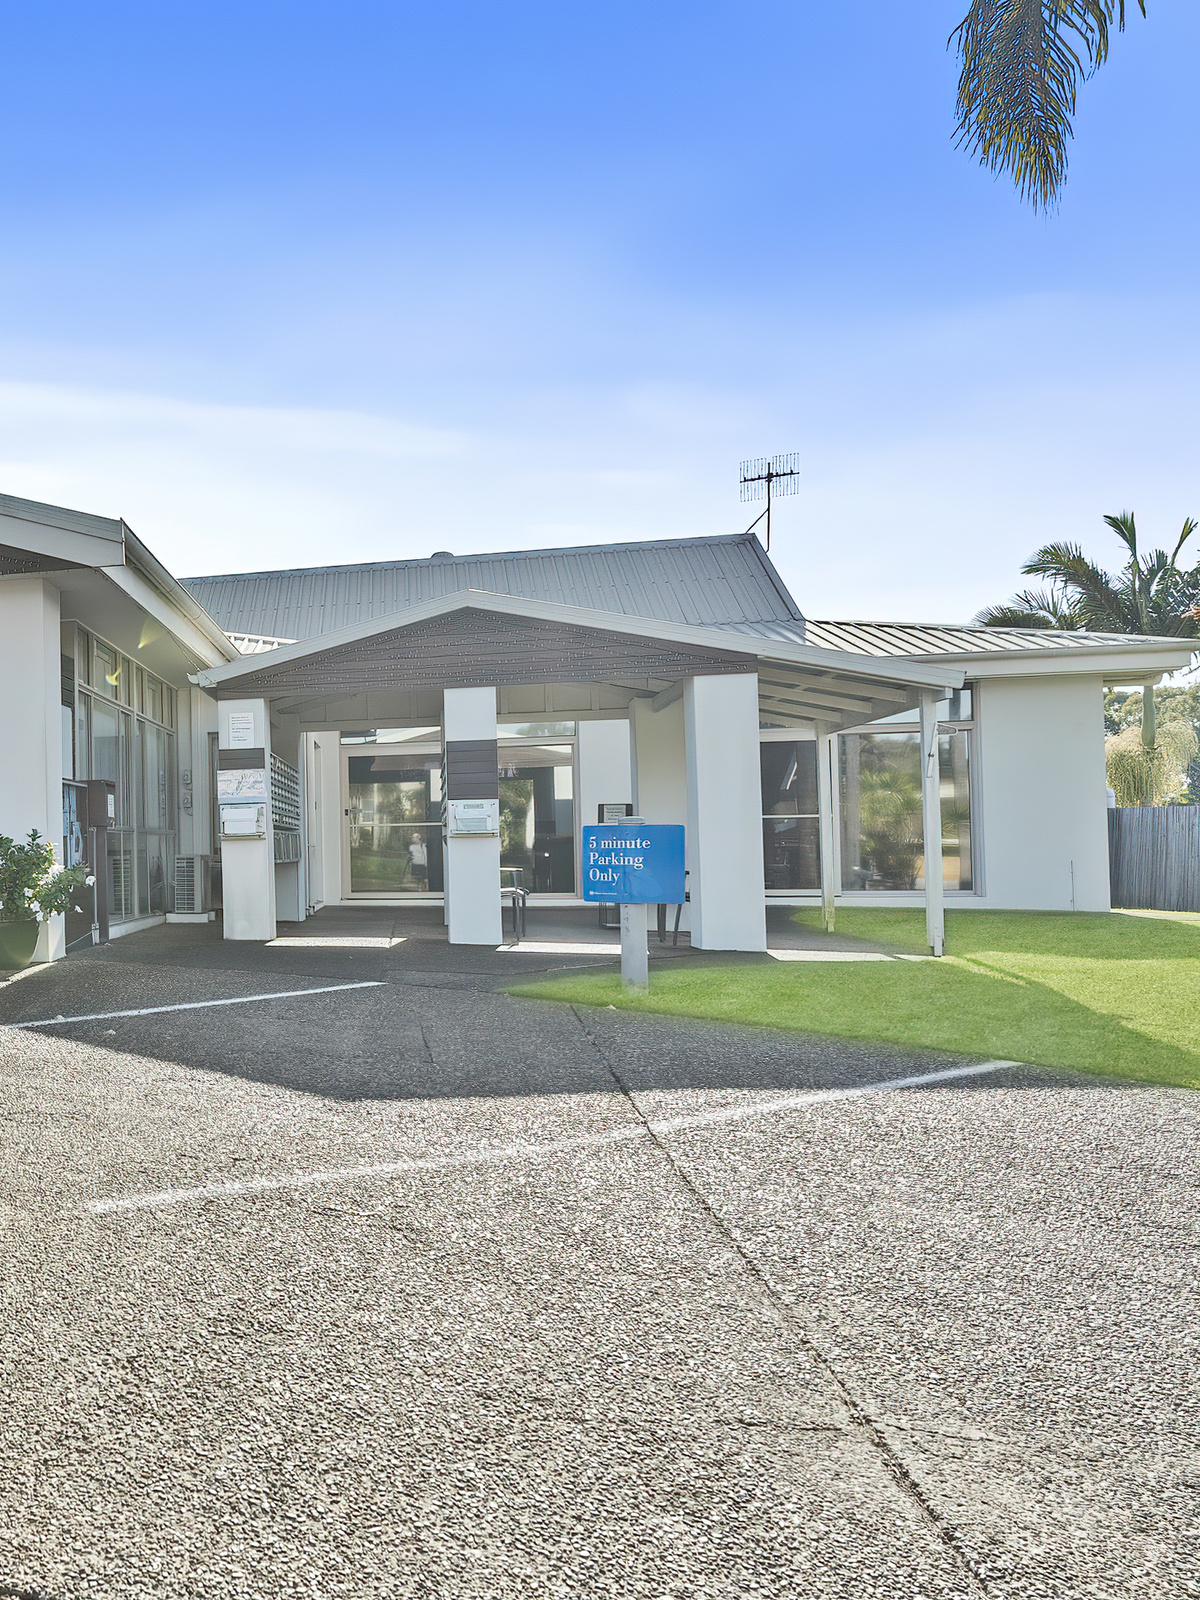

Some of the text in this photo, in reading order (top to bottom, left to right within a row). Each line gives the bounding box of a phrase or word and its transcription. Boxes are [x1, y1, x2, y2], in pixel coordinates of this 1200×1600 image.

[589, 836, 651, 849] 5 minute
[589, 852, 644, 870] Parking
[589, 868, 620, 886] Only
